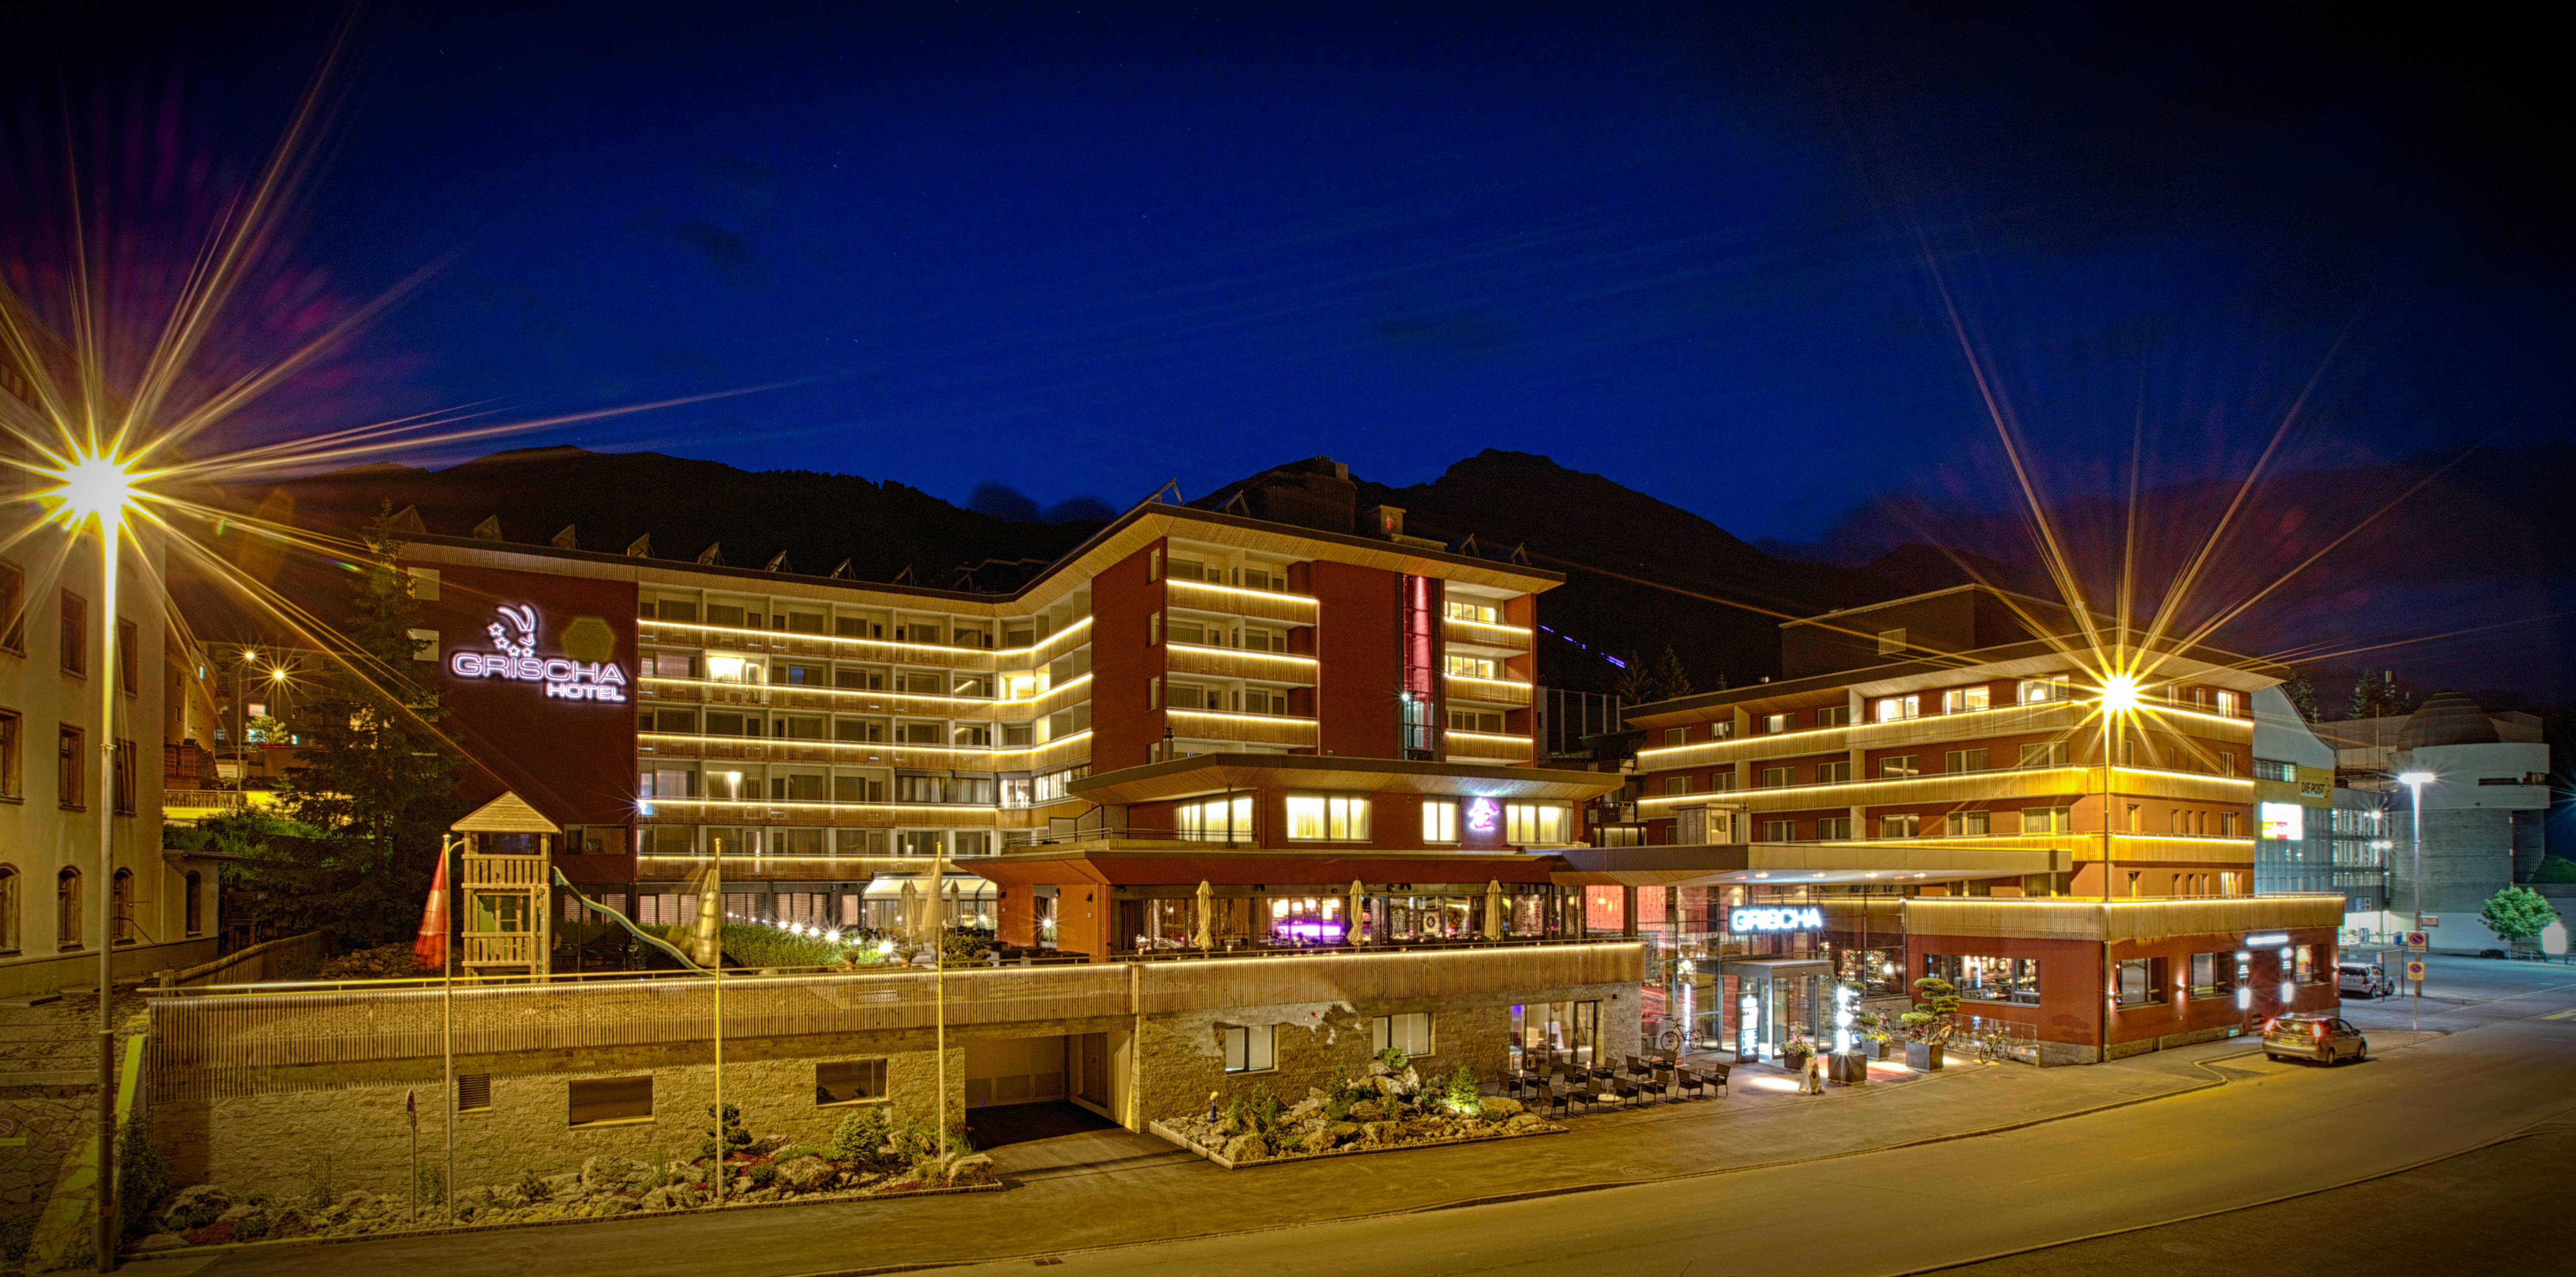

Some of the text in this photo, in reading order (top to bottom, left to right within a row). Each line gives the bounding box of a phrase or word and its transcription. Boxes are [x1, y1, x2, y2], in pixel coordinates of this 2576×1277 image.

[453, 653, 626, 685] GRISCHA
[547, 682, 626, 701] HOTEL
[2301, 782, 2325, 795] DIE POST
[1733, 909, 1821, 931] GRISCHA
